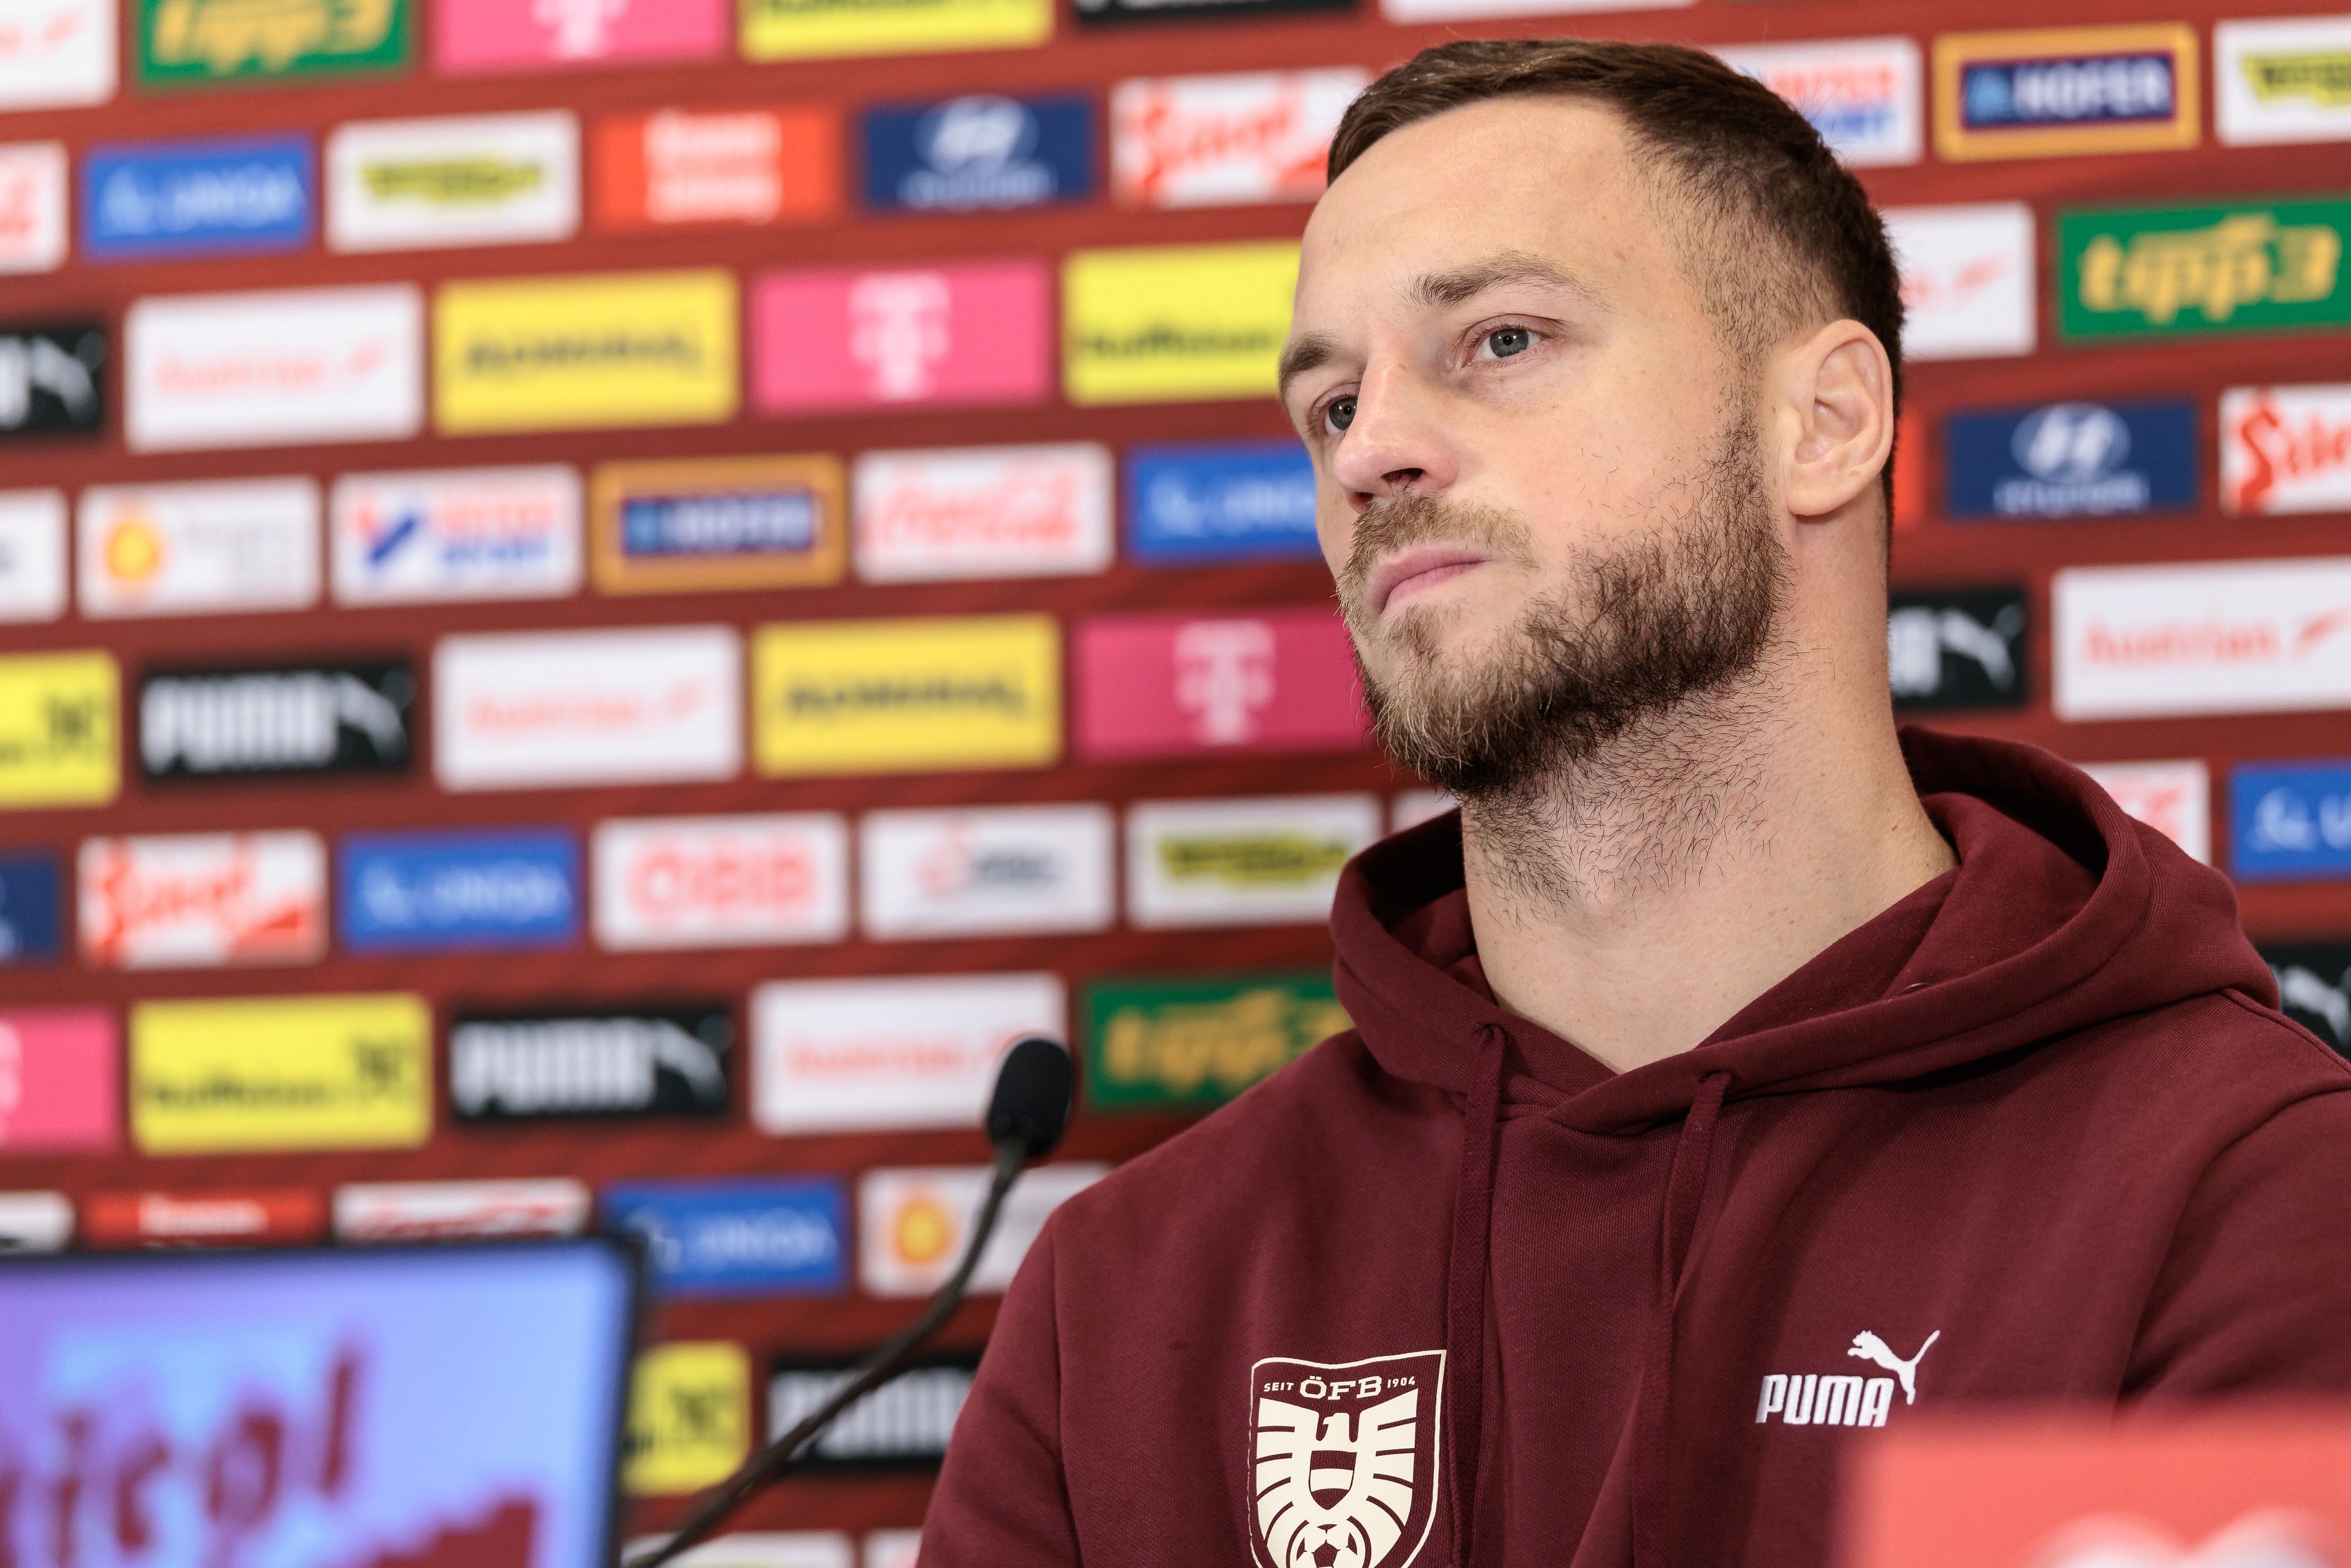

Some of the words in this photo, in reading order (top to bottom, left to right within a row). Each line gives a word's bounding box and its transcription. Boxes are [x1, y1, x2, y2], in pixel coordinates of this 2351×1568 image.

[2012, 56, 2172, 119] HOFER
[2078, 213, 2338, 323] tipp3
[2079, 614, 2282, 671] Austrian
[1264, 1382, 1294, 1392] SEIT
[1300, 1376, 1382, 1401] ÖFB
[1387, 1376, 1415, 1388] 1904
[1755, 1374, 1895, 1428] PUMA
